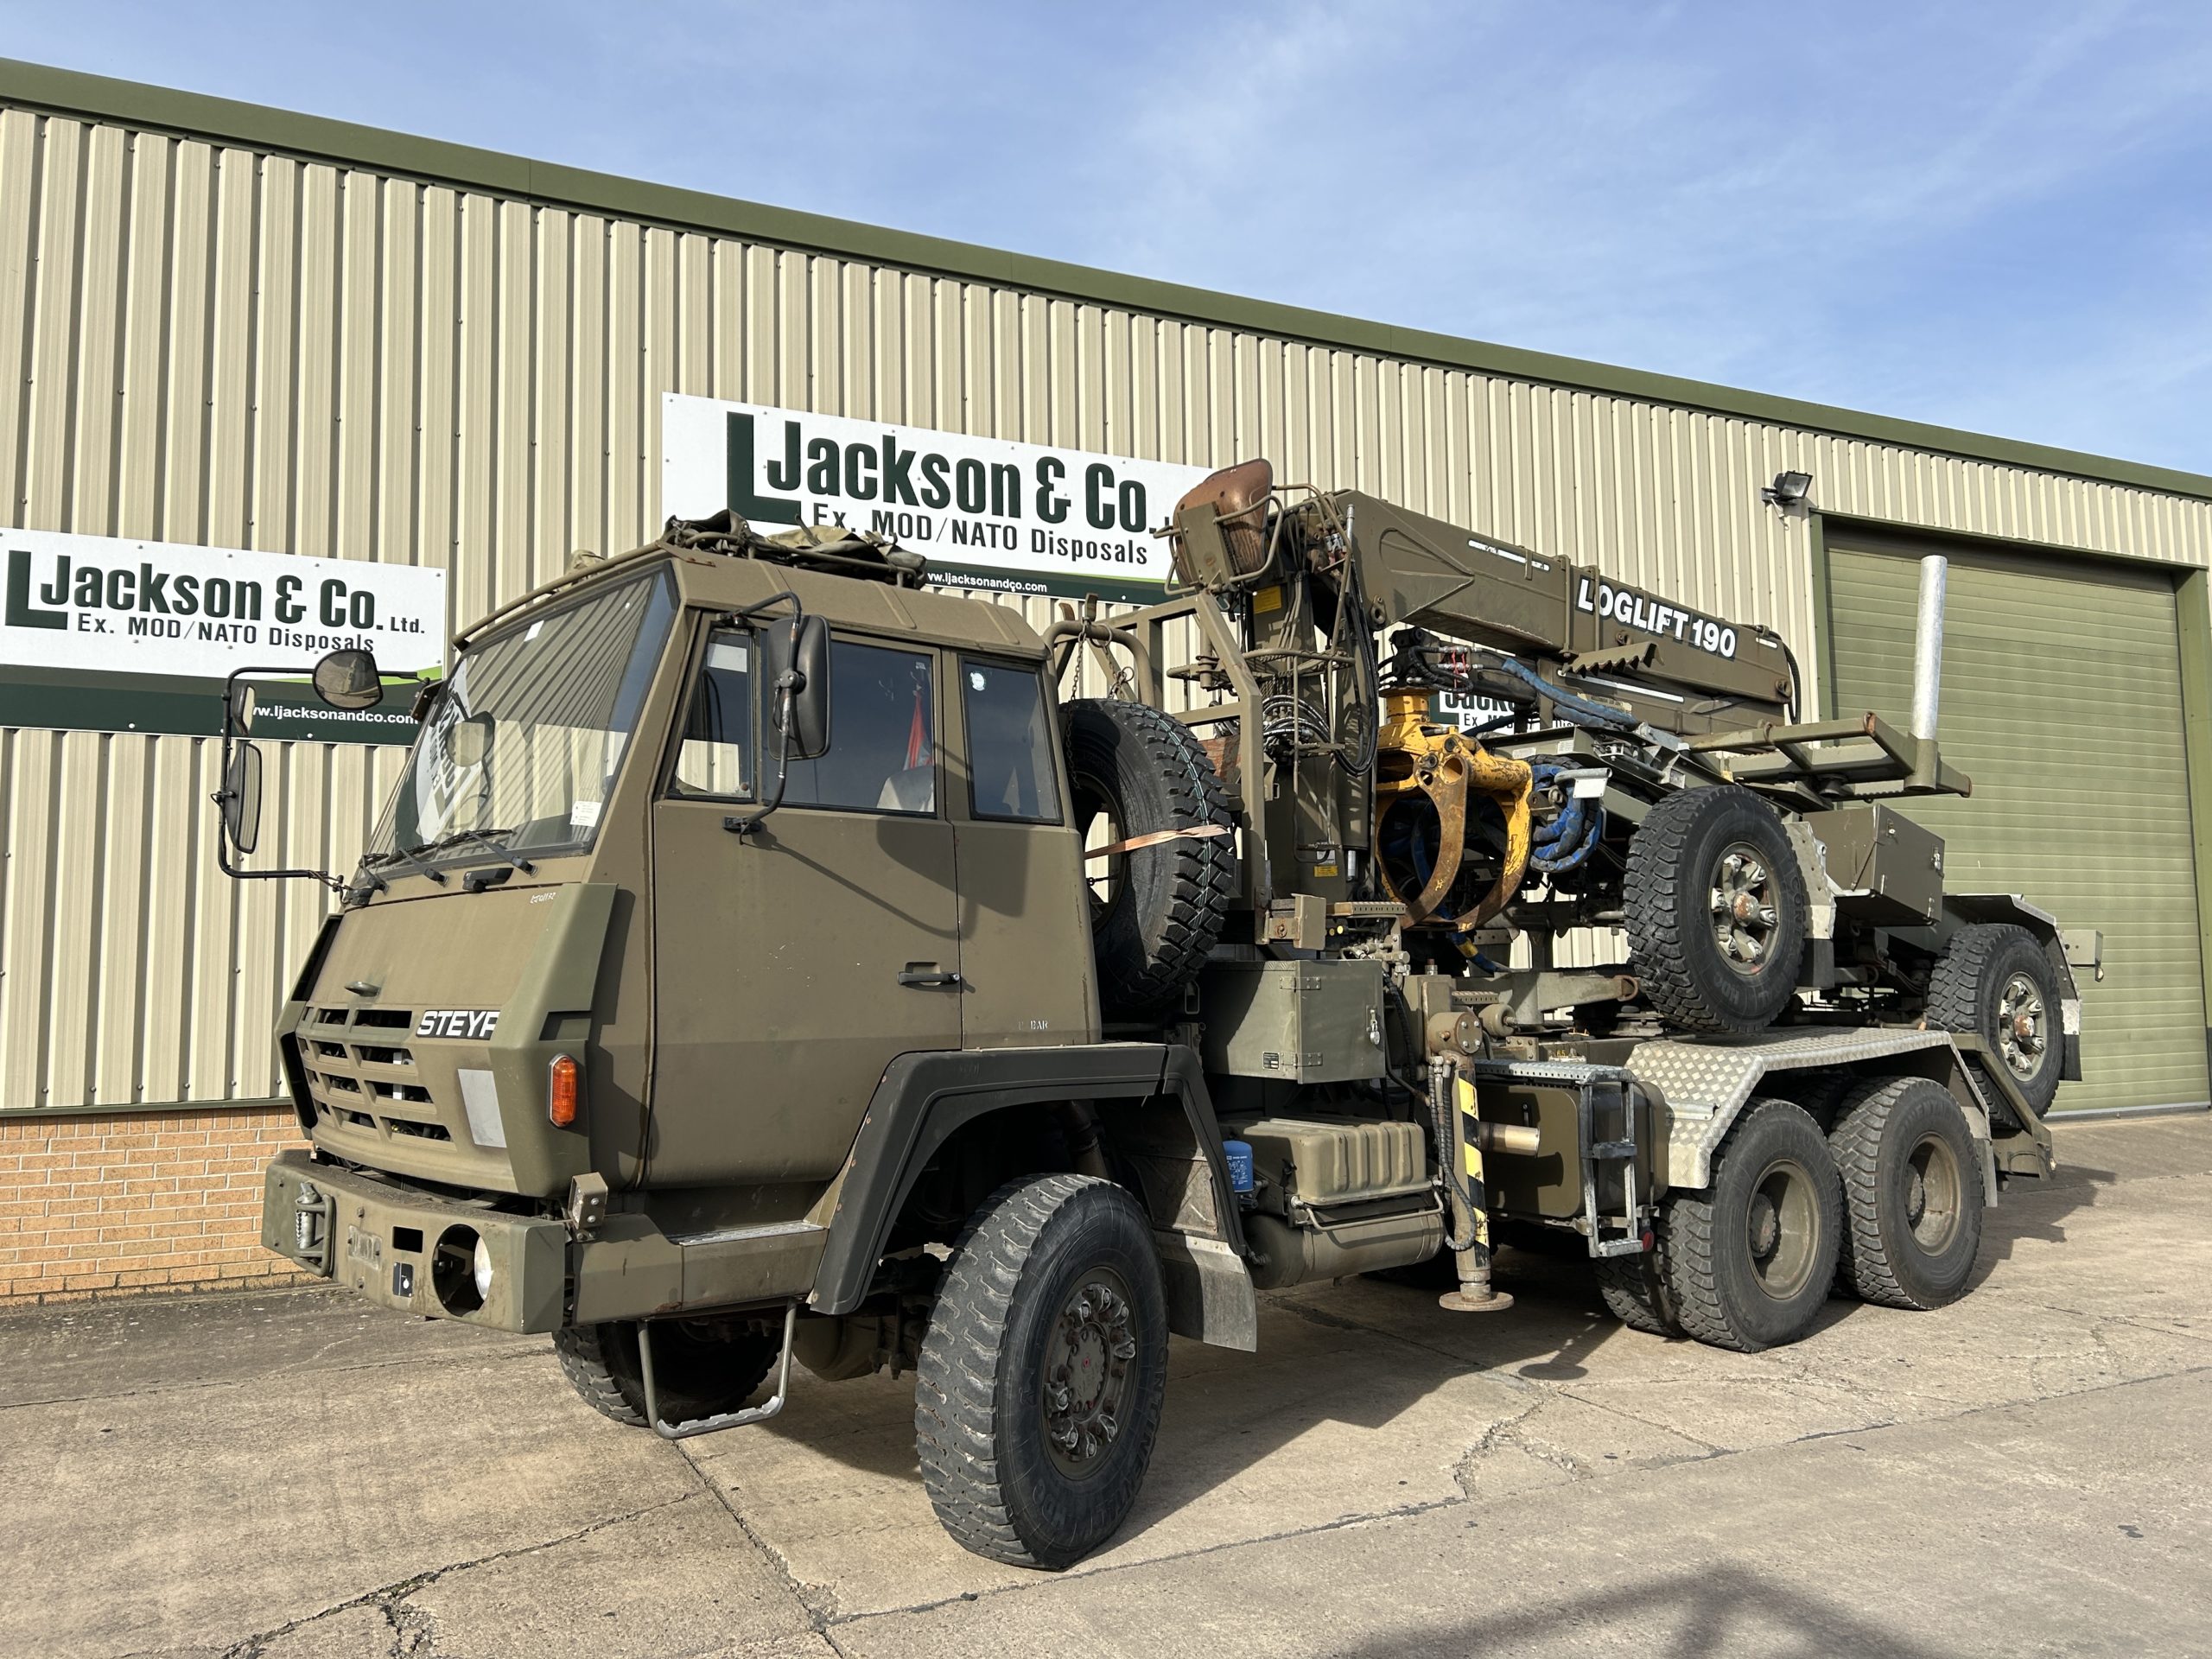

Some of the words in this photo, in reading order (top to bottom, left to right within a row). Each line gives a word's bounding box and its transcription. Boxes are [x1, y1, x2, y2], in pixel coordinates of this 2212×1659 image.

[1036, 456, 1071, 524] &
[1085, 463, 1156, 534] Co.
[813, 502, 856, 532] Ex.
[1031, 528, 1147, 564] Disposals
[78, 612, 115, 634] Ex.
[128, 616, 257, 644] MOD/NATO
[269, 626, 374, 652] Disposals
[275, 575, 307, 624] &
[320, 578, 384, 631] Co.
[391, 616, 425, 633] Ltd.
[1578, 578, 1689, 640] LOGLIFT
[1692, 619, 1736, 658] 190
